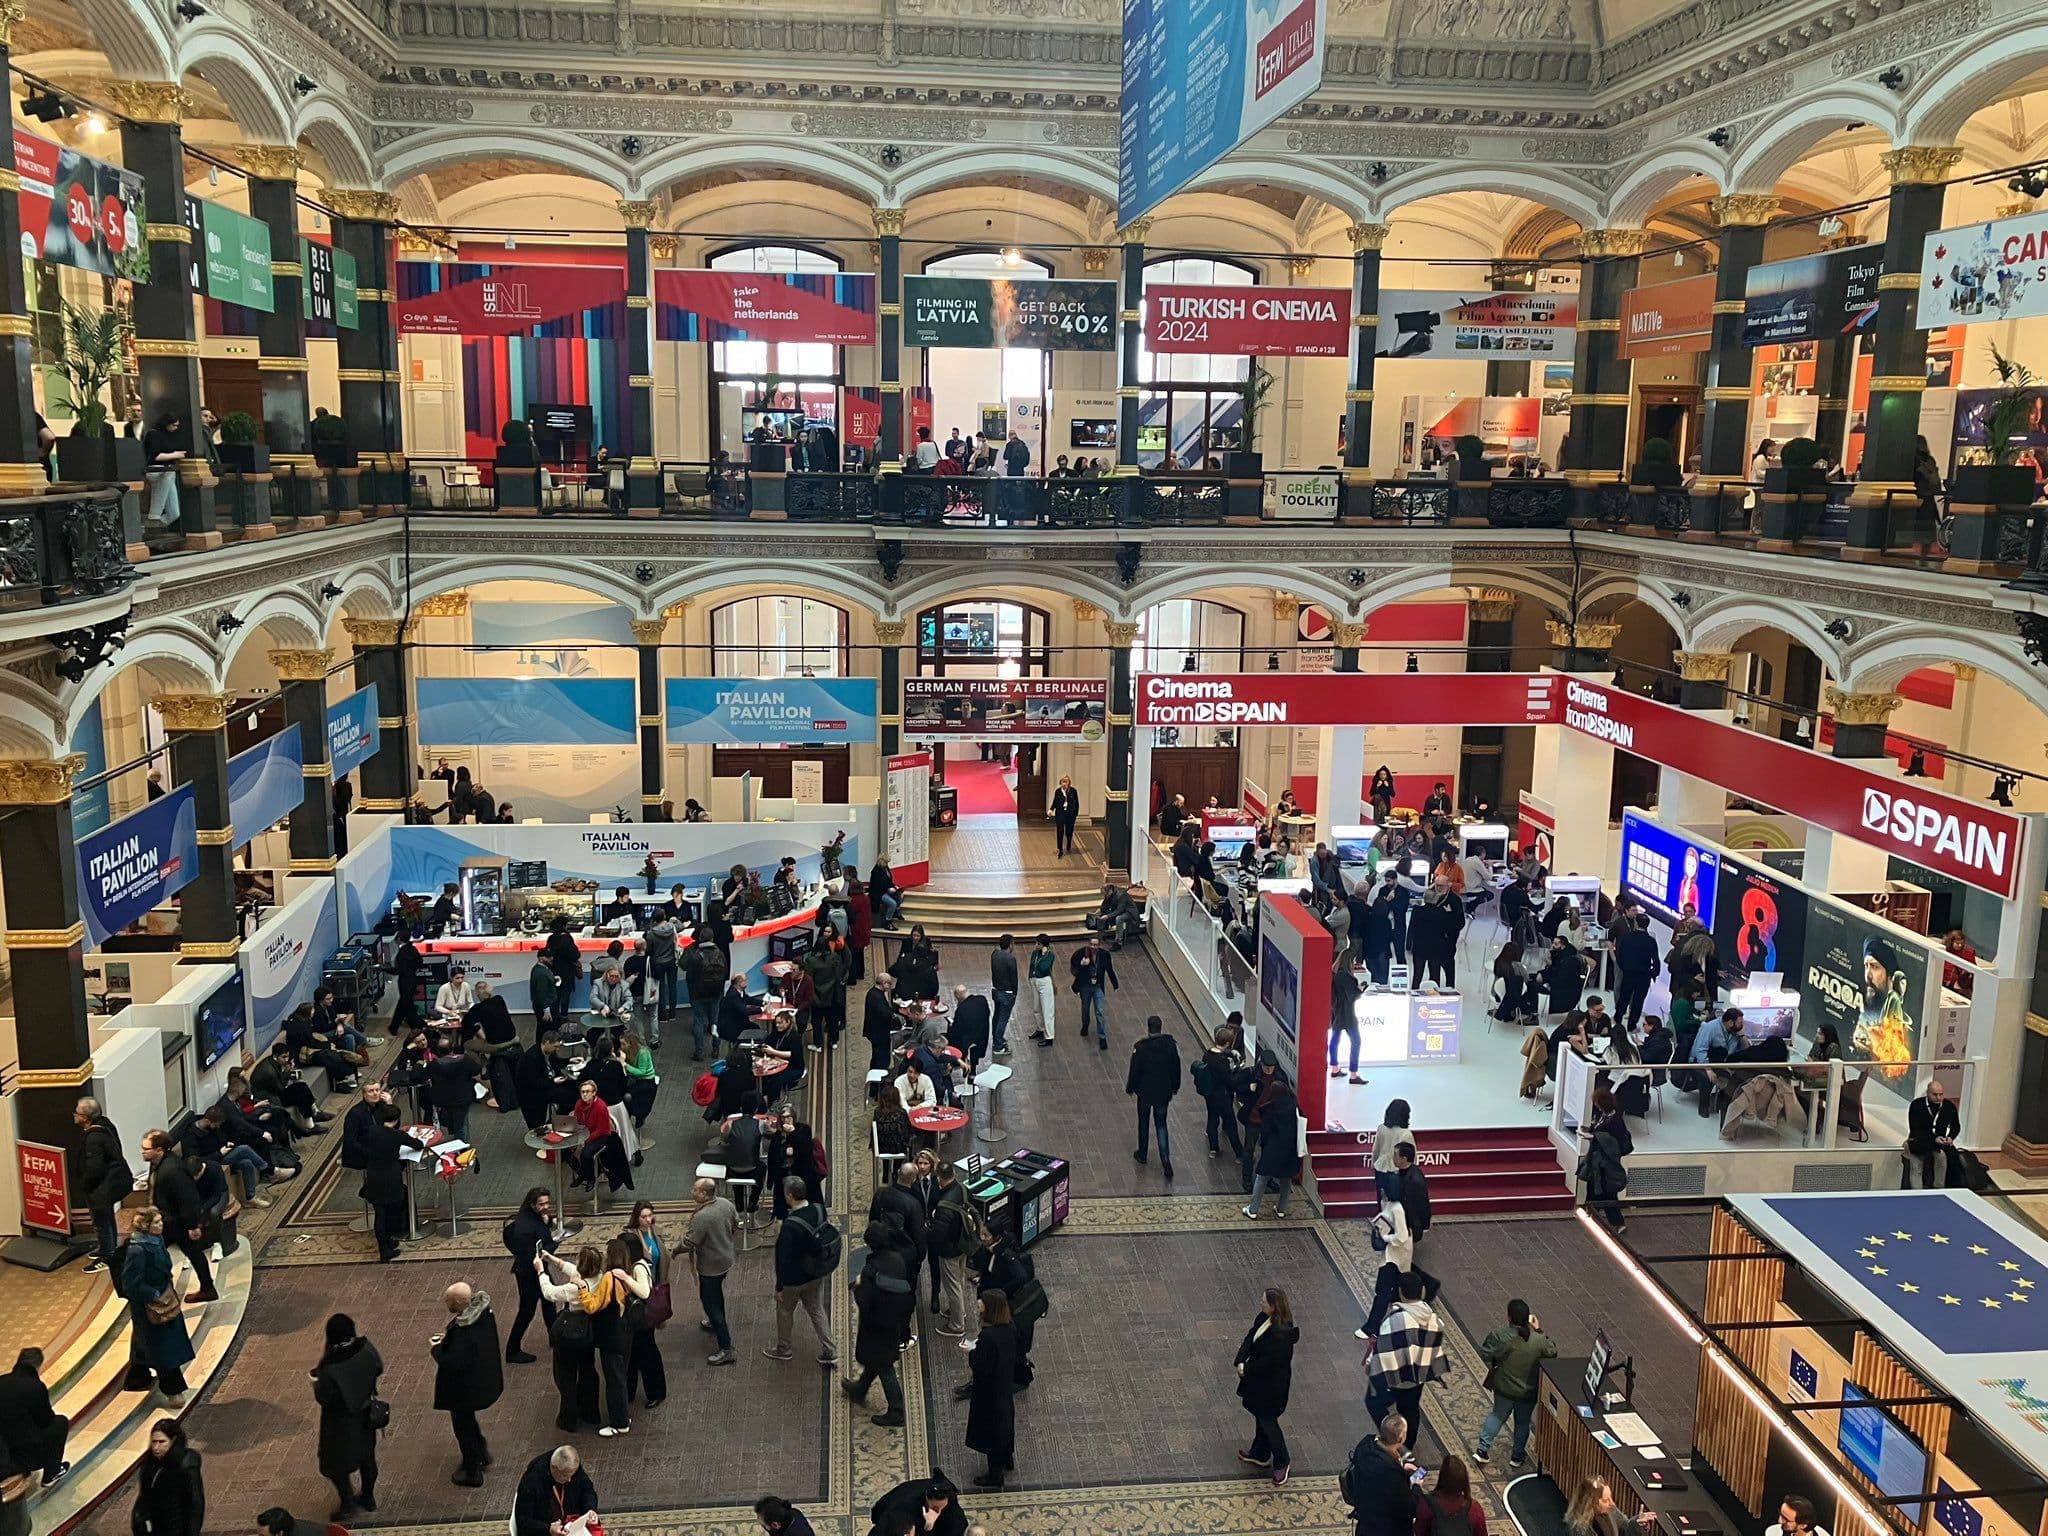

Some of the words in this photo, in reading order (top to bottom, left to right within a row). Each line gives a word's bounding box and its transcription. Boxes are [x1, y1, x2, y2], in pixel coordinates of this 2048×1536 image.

[1289, 19, 1313, 56] ITALIA
[1263, 44, 1283, 87] EFM
[311, 247, 331, 272] BEL
[1848, 264, 1875, 281] Tokyo
[313, 272, 324, 294] GI
[733, 286, 759, 297] take
[1847, 285, 1864, 297] Film
[484, 283, 496, 312] SEE
[496, 283, 541, 313] NL
[734, 298, 753, 308] the
[916, 299, 962, 309] FILMING
[965, 300, 977, 309] IN
[1019, 302, 1045, 312] GET
[1049, 302, 1086, 313] BACK
[1460, 298, 1493, 309] North
[1495, 299, 1556, 309] Macedonia
[314, 297, 331, 319] UM
[414, 314, 428, 322] eye
[734, 309, 799, 321] netherlands
[916, 309, 980, 323] LATVIA
[1159, 297, 1246, 319] TURKISH
[1252, 300, 1337, 321] CINEMA
[1458, 311, 1485, 321] Film
[1489, 311, 1526, 324] Agency
[1020, 315, 1037, 324] UP
[1041, 315, 1059, 325] TO
[1060, 314, 1109, 334] 40%
[1631, 310, 1663, 334] NATIVe
[1773, 314, 1788, 323] Booth
[1157, 321, 1208, 342] 2024
[854, 413, 863, 434] SEE
[1287, 483, 1331, 494] GREEN
[1281, 495, 1339, 506] TOOLKIT
[906, 683, 963, 692] GERMAN
[970, 683, 1008, 693] FILMS
[1014, 683, 1029, 693] AT
[1036, 683, 1105, 693] BERLINALE
[1147, 678, 1233, 698] Cinema
[1567, 681, 1608, 712] Cinema
[716, 692, 784, 705] ITALIAN
[730, 707, 812, 719] PAVILION
[1147, 702, 1194, 723] from
[1214, 702, 1287, 722] SPAIN
[1526, 713, 1546, 721] Spain
[328, 713, 351, 738] ITALIAN
[1566, 704, 1589, 729] from
[1597, 716, 1634, 747] SPAIN
[333, 723, 360, 750] PAVILION
[582, 833, 630, 841] ITALIAN
[592, 842, 649, 851] PAVILION
[1890, 799, 2007, 876] SPAIN
[90, 835, 139, 881] ITALIAN
[102, 847, 158, 898] PAVILION
[112, 887, 128, 903] BERLIN
[128, 869, 159, 893] INTERNATIONAL
[131, 889, 141, 900] FILM
[141, 878, 159, 894] FESTIVAL
[264, 933, 286, 960] ITALIAN
[268, 938, 293, 968] PAVILION
[1808, 966, 1865, 1013] RAQQA
[31, 1157, 56, 1174] EFM
[1416, 1153, 1450, 1165] PAIN
[24, 1173, 52, 1187] LUNCH
[1023, 1217, 1037, 1233] GLASS
